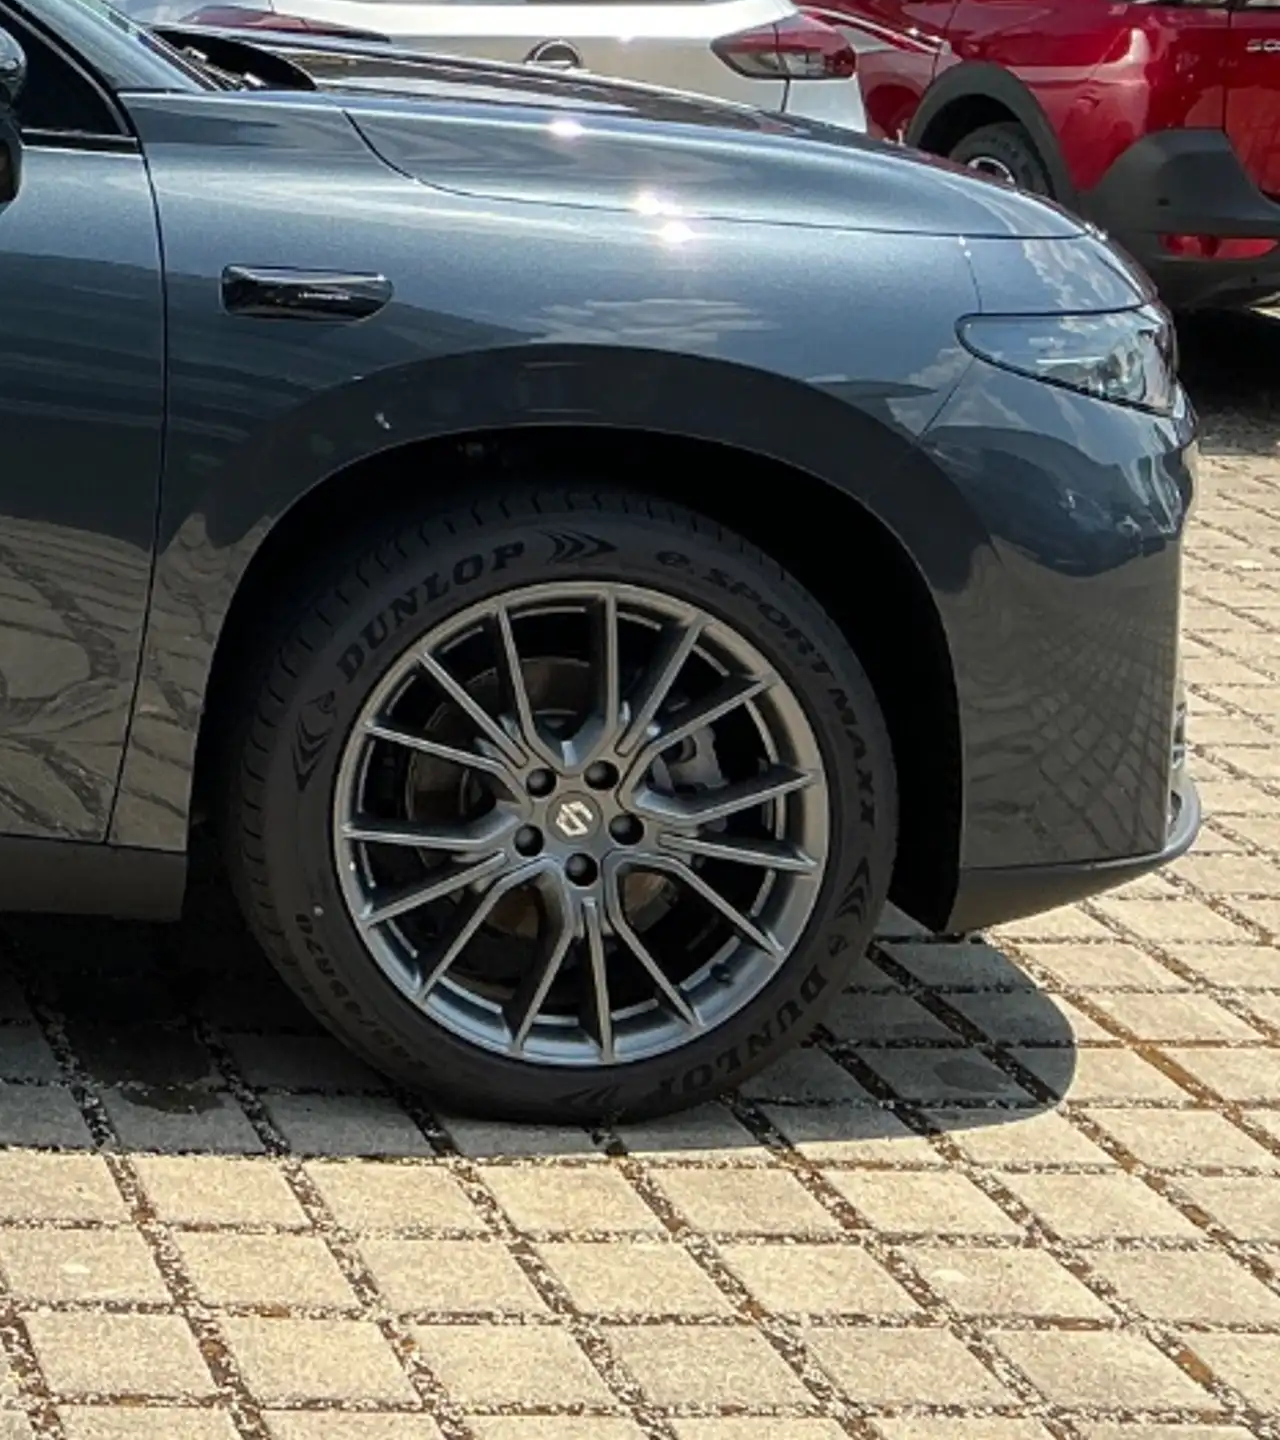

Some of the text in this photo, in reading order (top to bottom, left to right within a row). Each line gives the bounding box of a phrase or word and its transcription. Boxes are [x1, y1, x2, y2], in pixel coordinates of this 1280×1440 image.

[334, 539, 526, 682] DUNLOP
[705, 565, 836, 682] SPORT
[829, 687, 875, 828] MAXX
